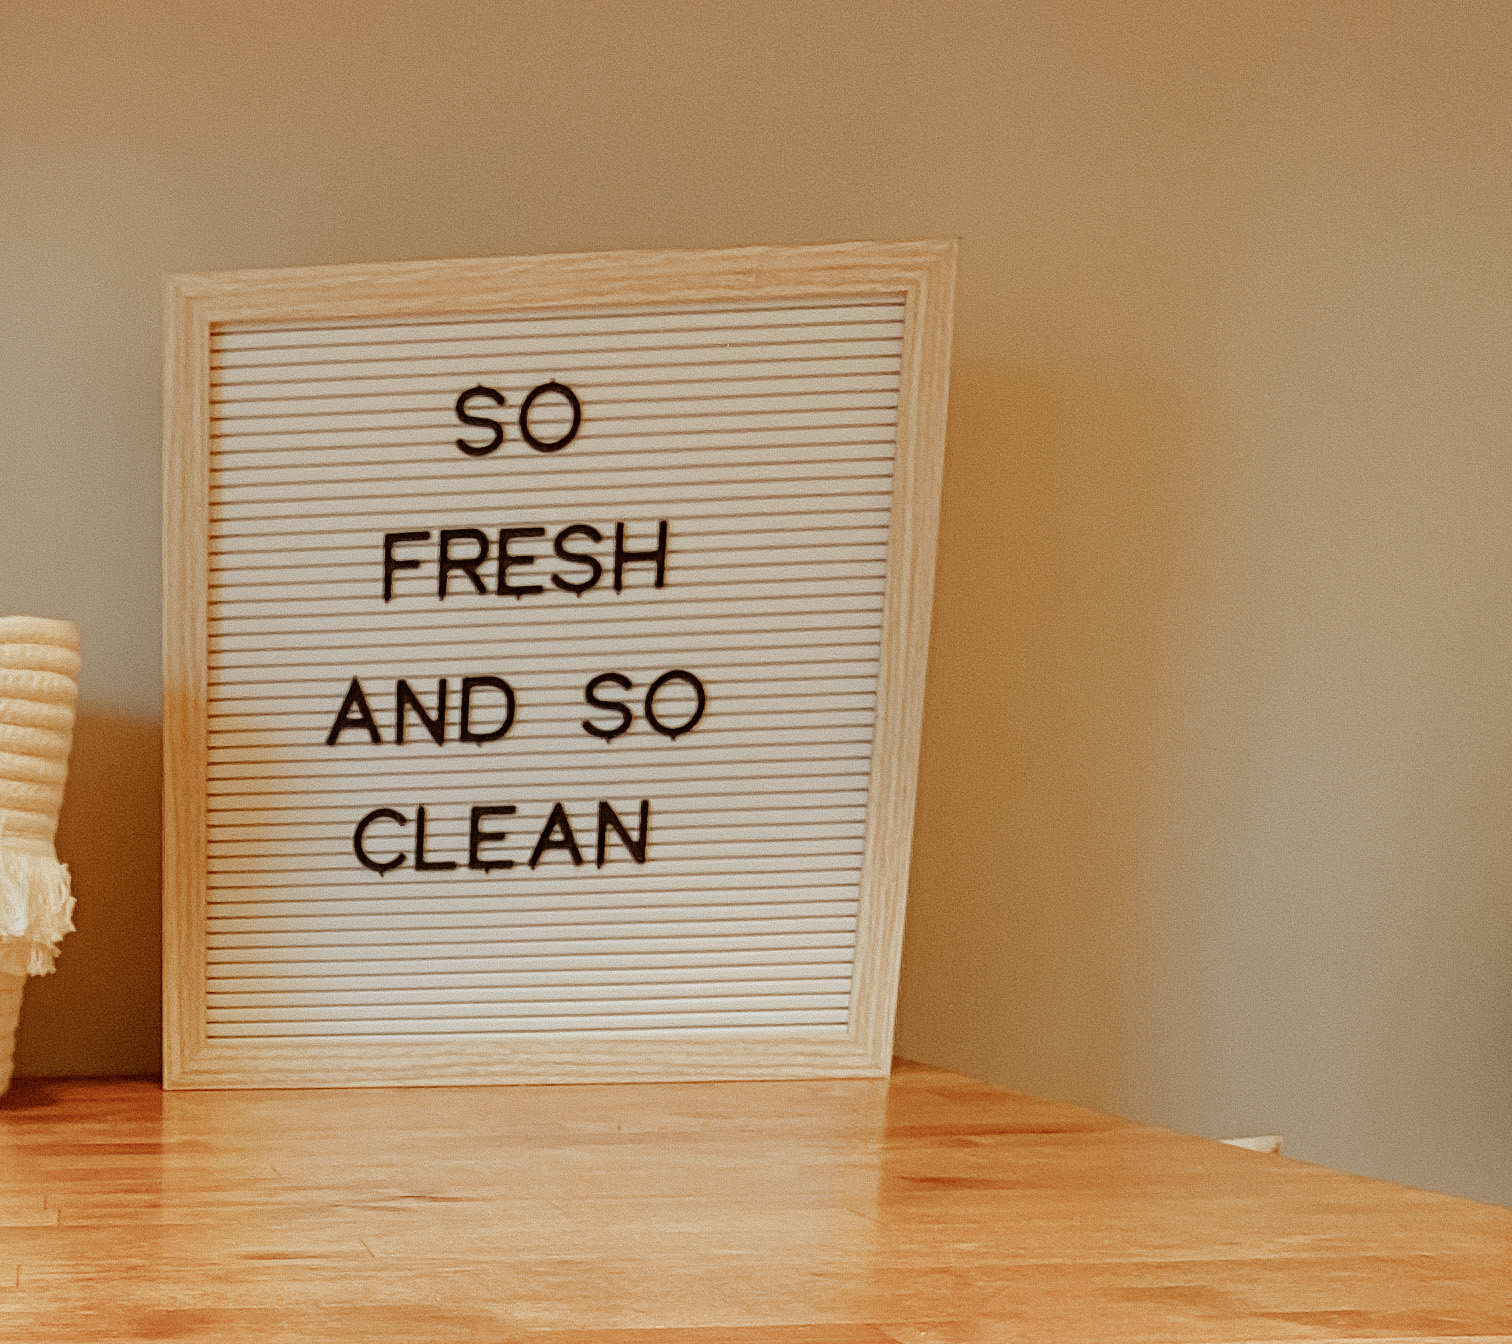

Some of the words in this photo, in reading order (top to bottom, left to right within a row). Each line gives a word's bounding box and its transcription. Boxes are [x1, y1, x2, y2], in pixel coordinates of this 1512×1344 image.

[454, 381, 582, 456] SO
[381, 519, 669, 603] FRESH
[325, 675, 516, 745] AND
[581, 669, 707, 741] SO
[352, 800, 651, 875] CLEAN
